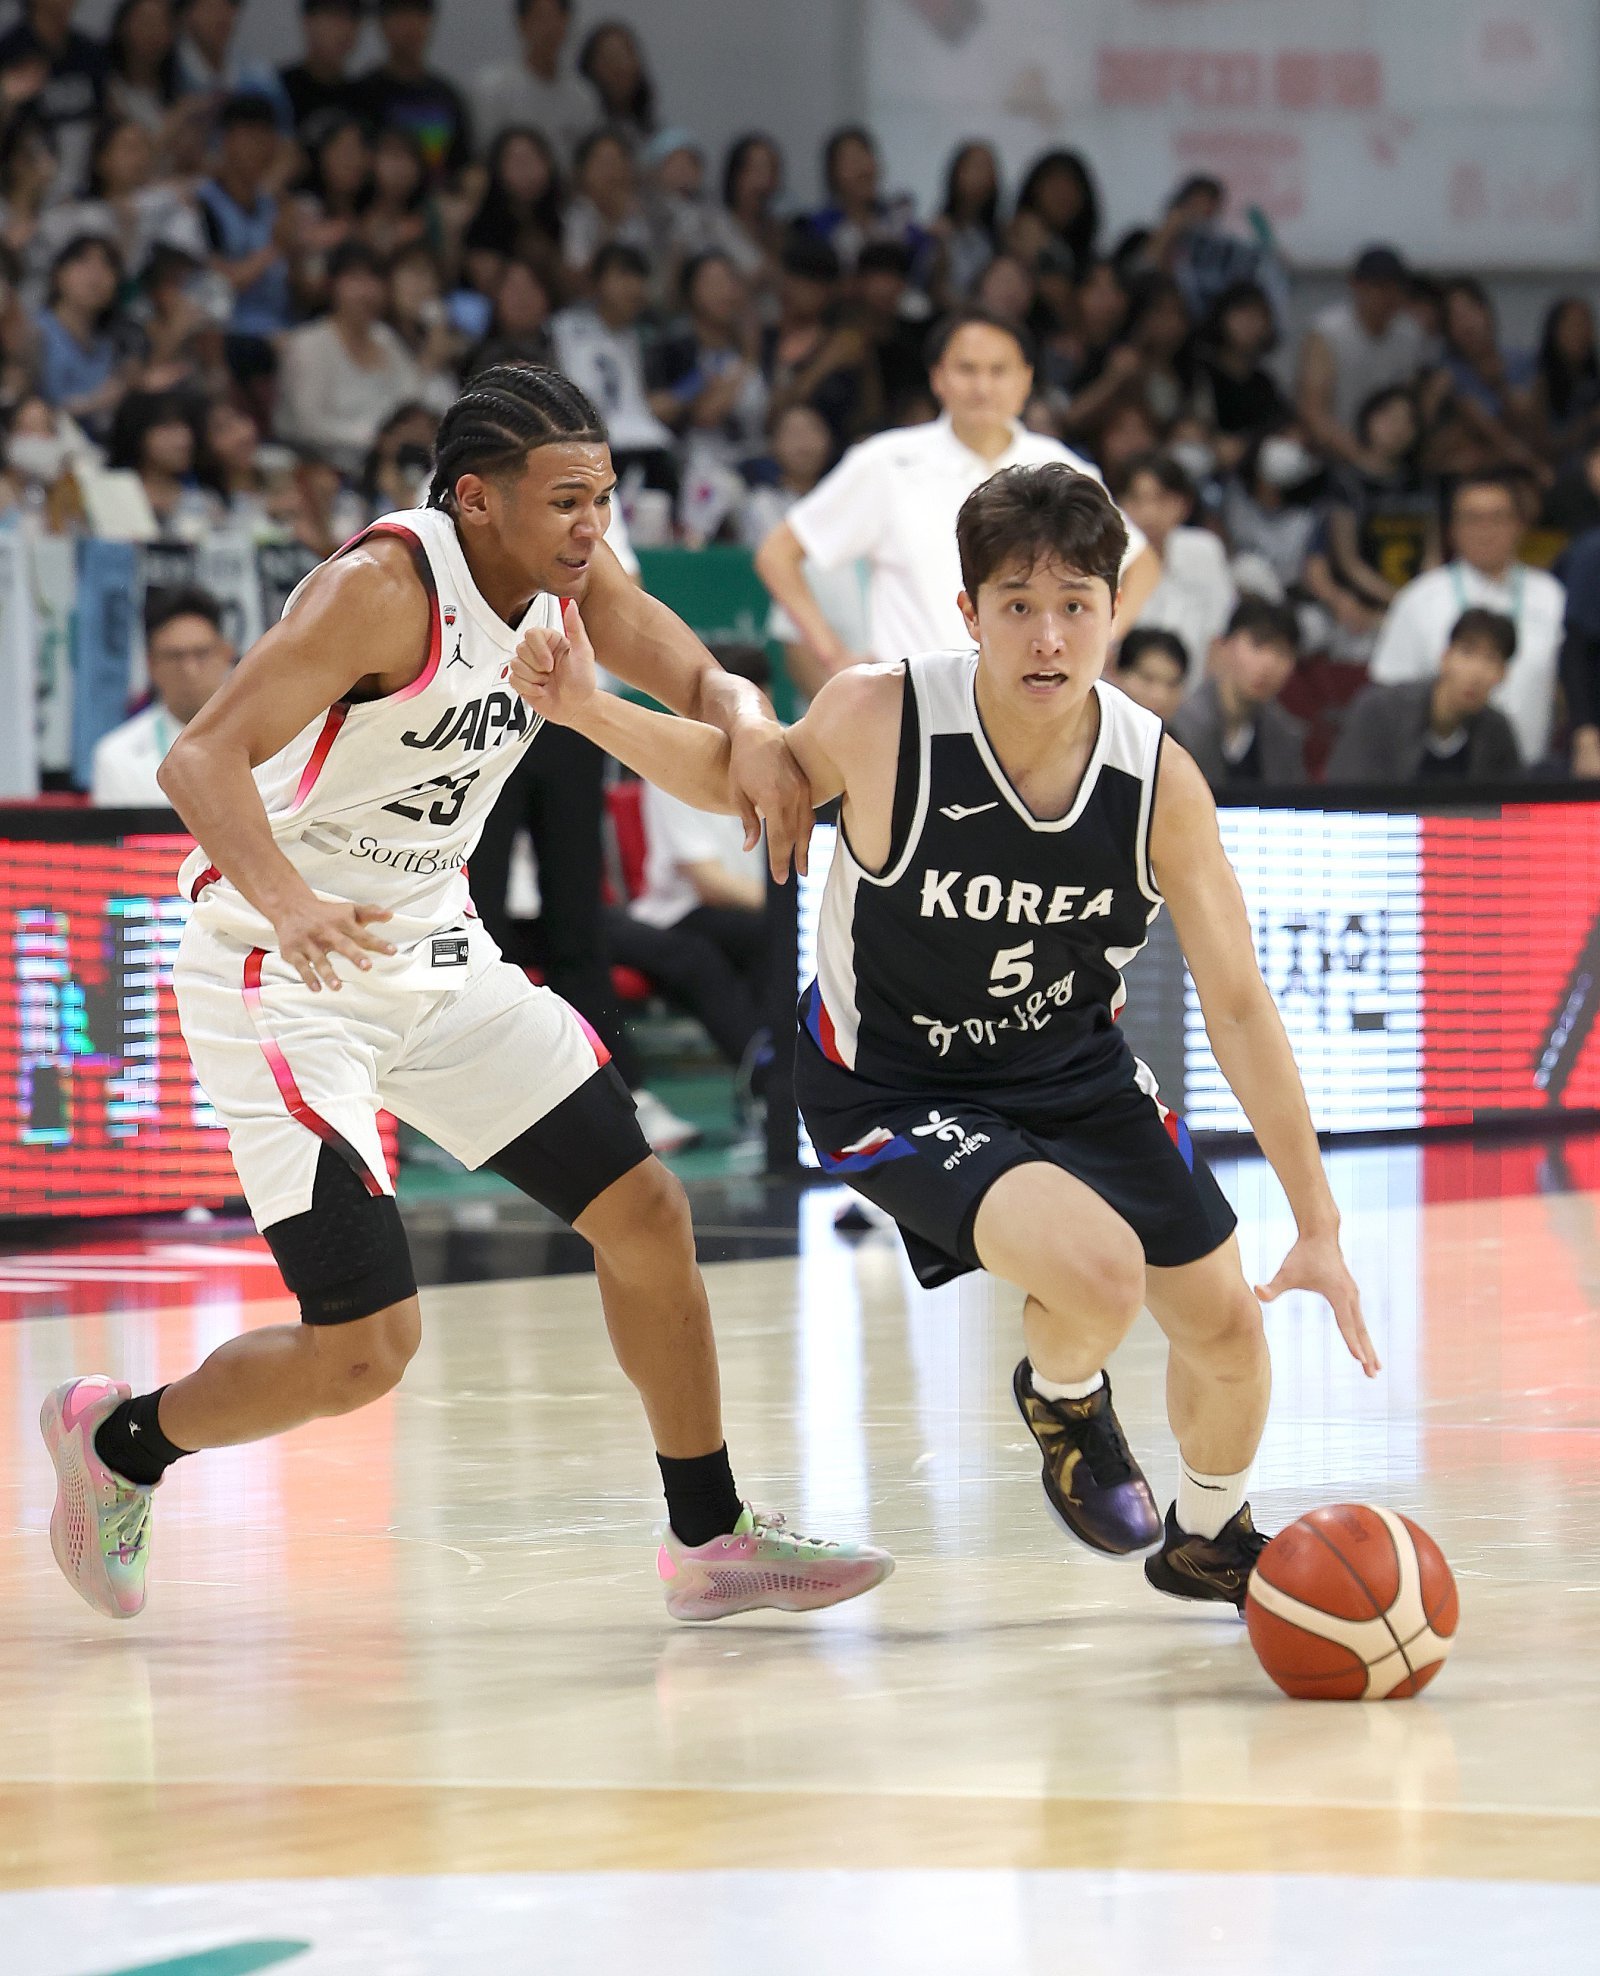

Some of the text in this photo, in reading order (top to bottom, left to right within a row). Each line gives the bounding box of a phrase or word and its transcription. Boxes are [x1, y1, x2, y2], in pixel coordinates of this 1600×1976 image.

[381, 769, 480, 826] 23
[919, 868, 1114, 926] KOREA
[987, 939, 1035, 998] 5
